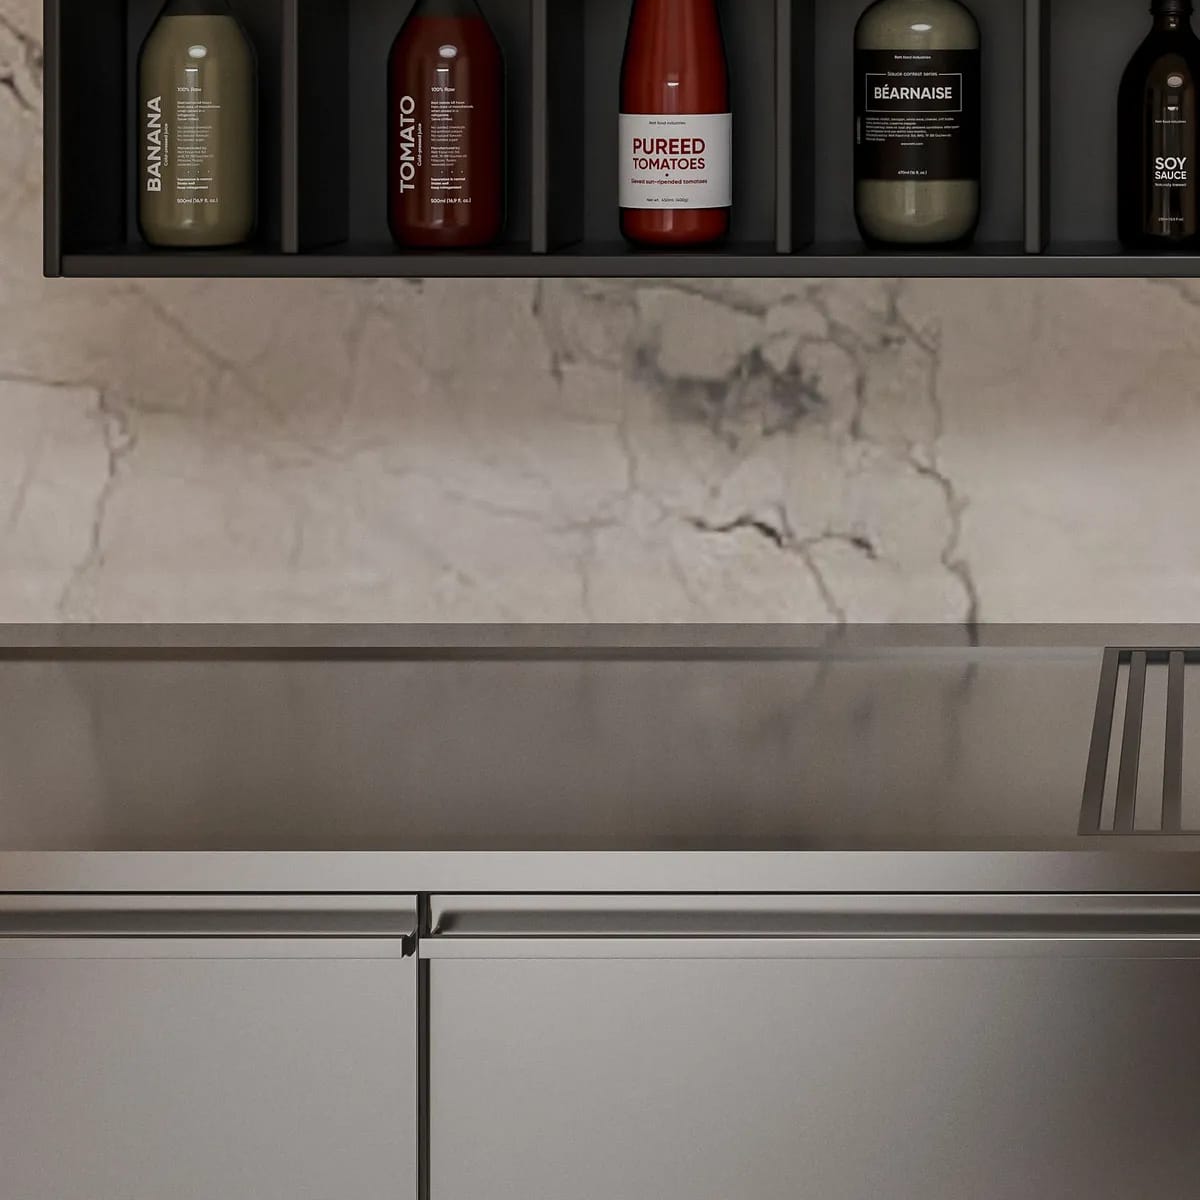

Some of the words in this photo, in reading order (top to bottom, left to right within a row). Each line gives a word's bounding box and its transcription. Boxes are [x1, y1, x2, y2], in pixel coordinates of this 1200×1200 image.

[874, 84, 953, 99] BÉARNAISE
[147, 96, 161, 192] BANANA
[400, 95, 415, 193] TOMATO
[632, 138, 706, 155] PUREED
[632, 158, 706, 170] TOMATOES
[1155, 157, 1187, 170] SOY
[1155, 171, 1187, 180] SAUCE
